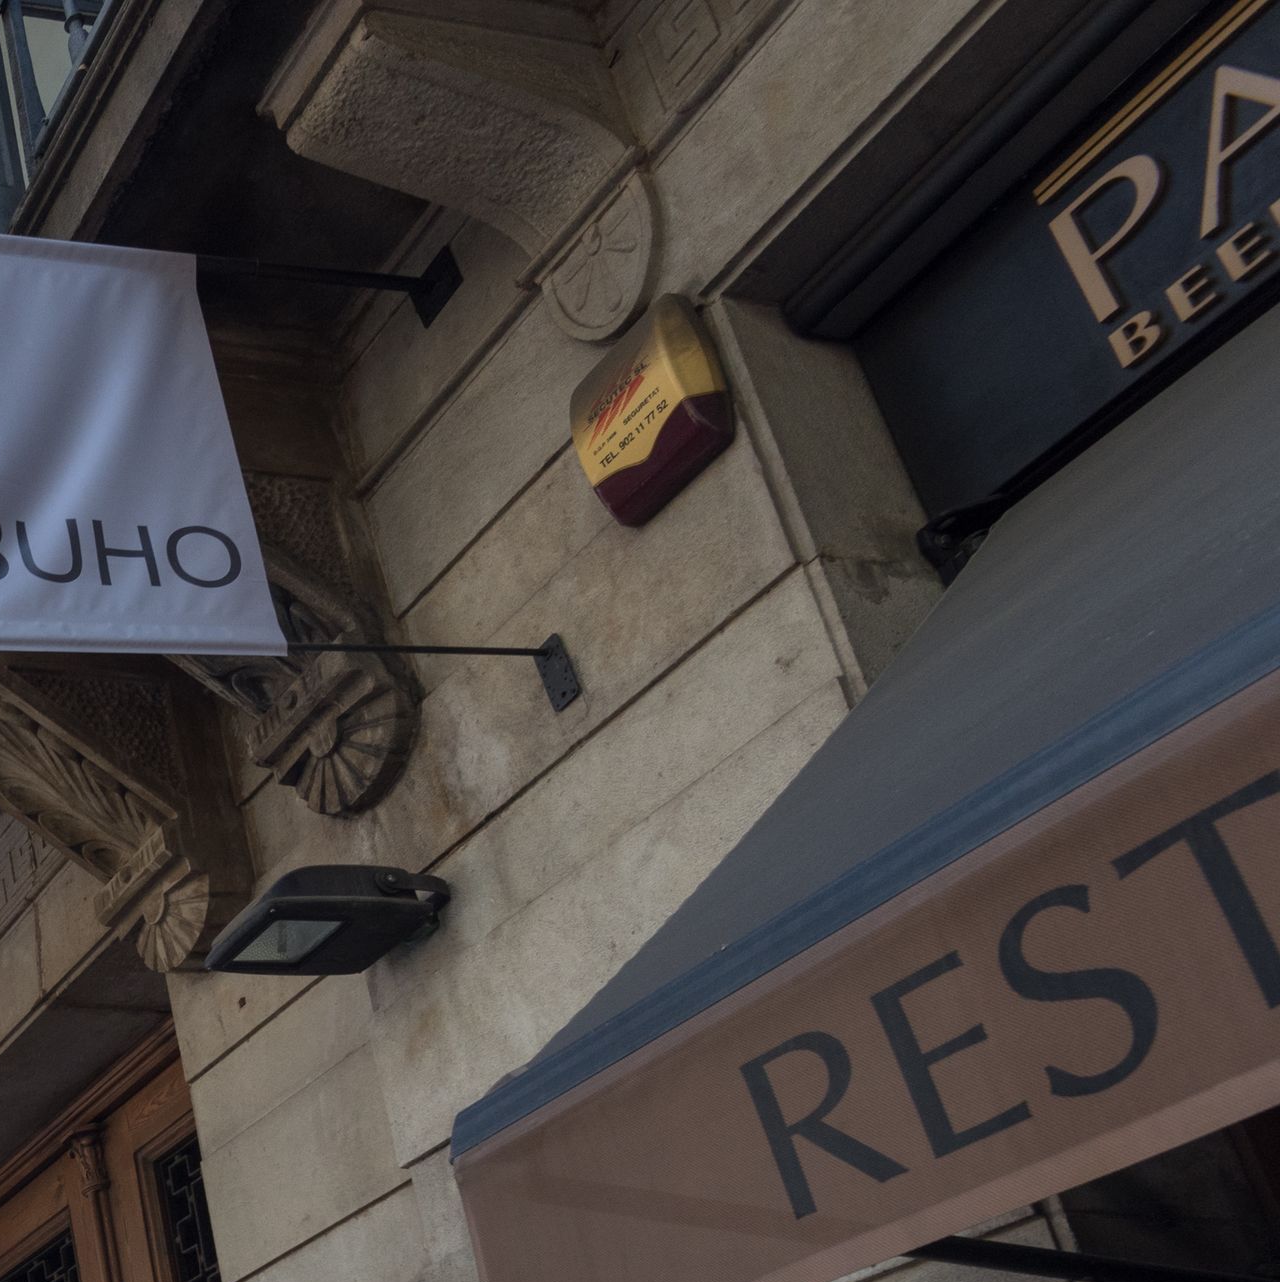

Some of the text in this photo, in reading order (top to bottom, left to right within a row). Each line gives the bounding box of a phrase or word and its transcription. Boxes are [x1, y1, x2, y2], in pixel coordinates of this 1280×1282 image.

[1108, 198, 1280, 369] BEE
[619, 432, 635, 450] 902
[635, 422, 645, 434] 11
[644, 410, 655, 425] 77
[656, 400, 668, 414] 52
[623, 387, 660, 425] SEGURETAT
[740, 769, 1280, 1220] REST
